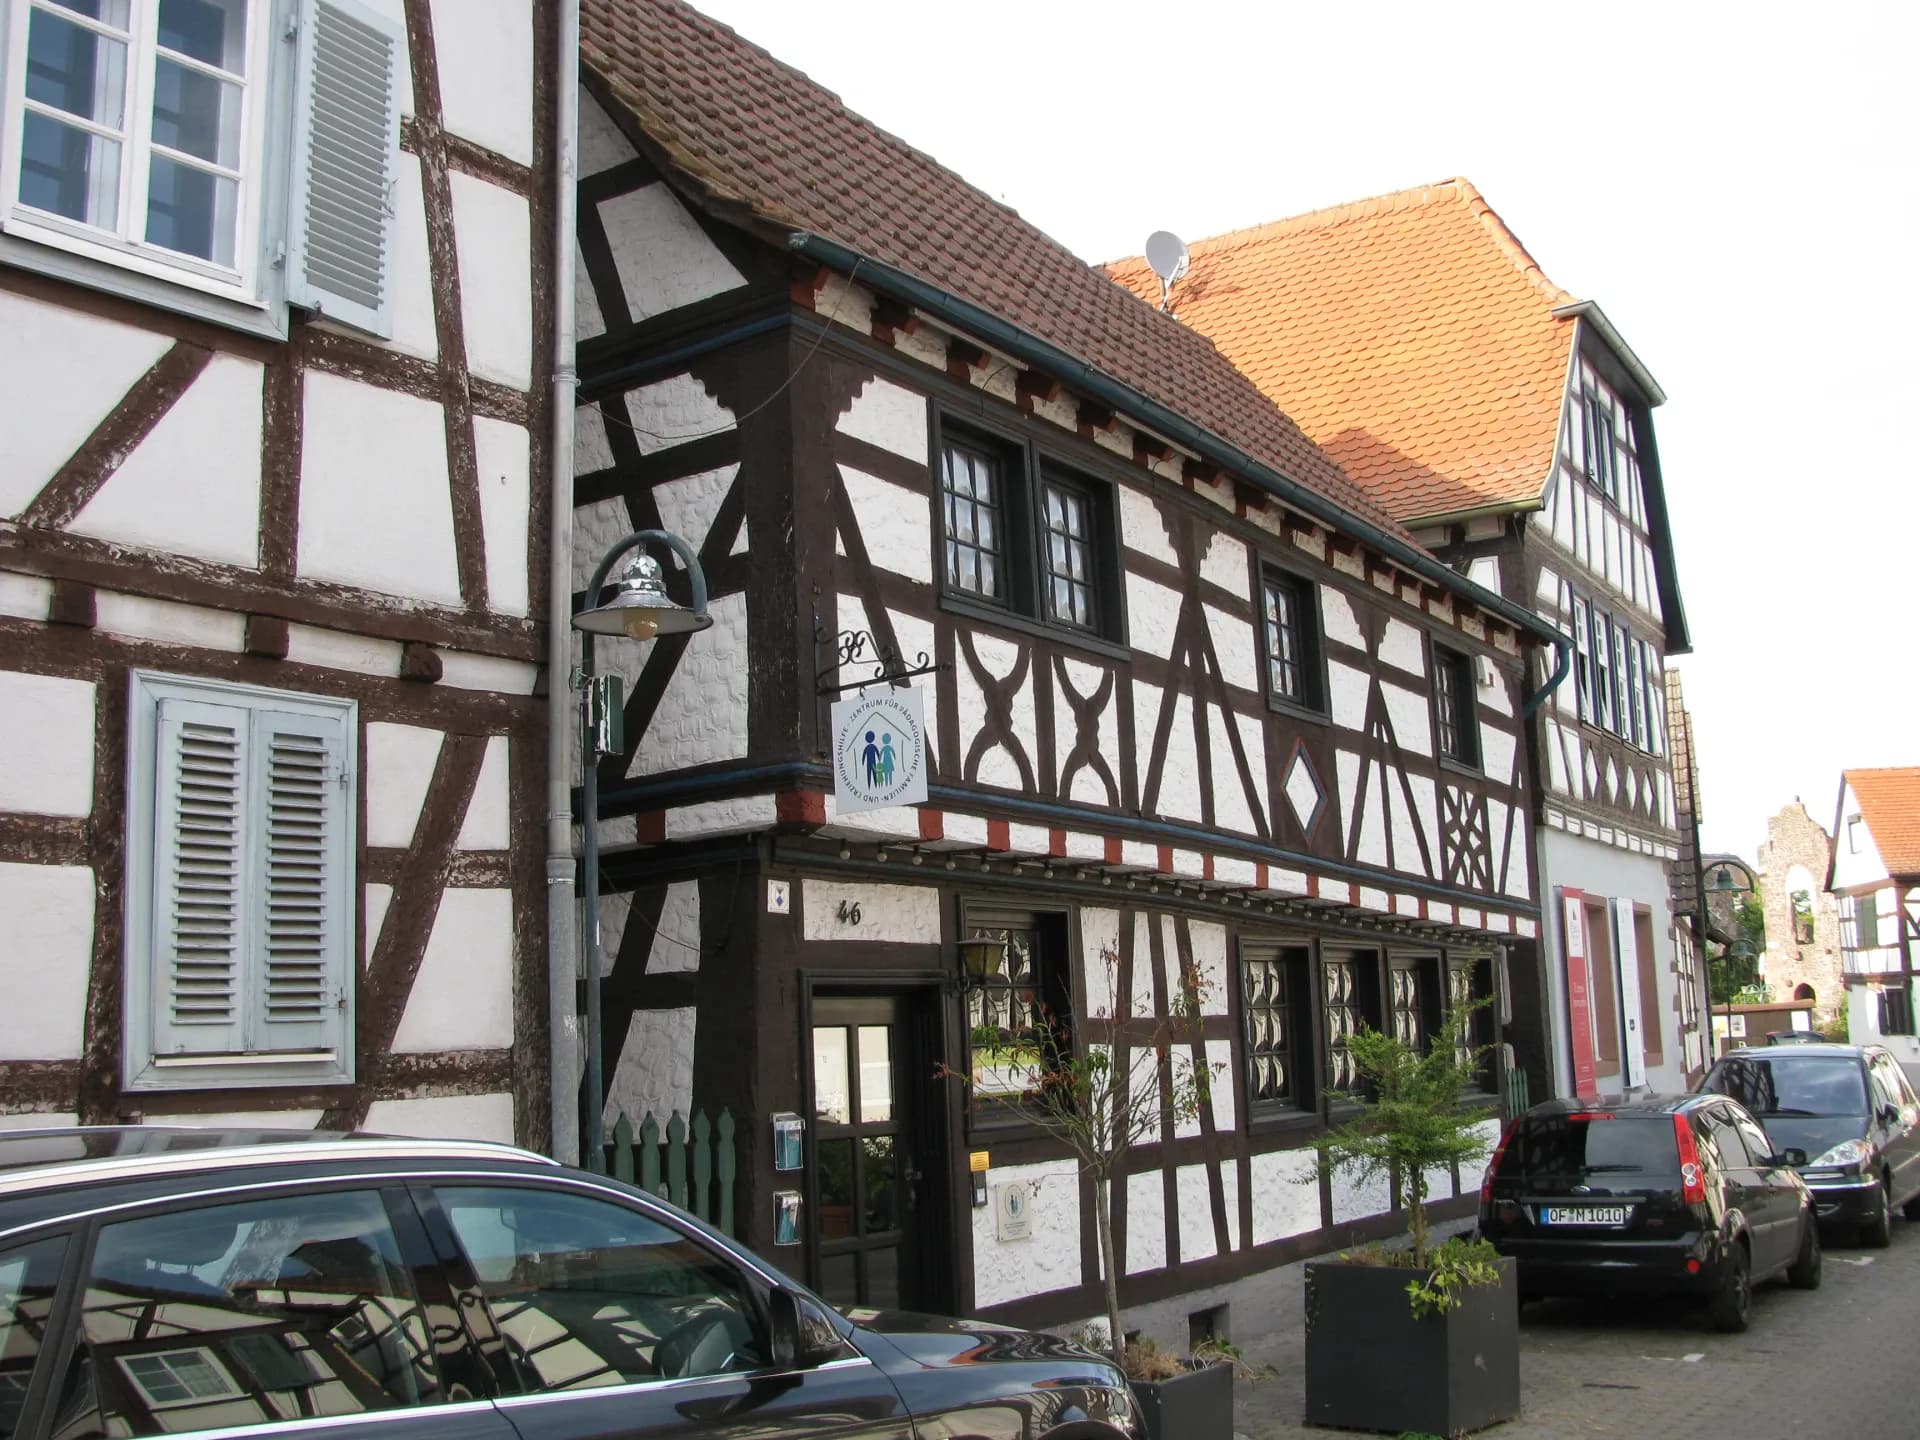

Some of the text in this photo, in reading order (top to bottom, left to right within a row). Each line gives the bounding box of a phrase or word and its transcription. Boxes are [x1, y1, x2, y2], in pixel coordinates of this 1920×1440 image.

[849, 699, 883, 722] ZENTRUM
[884, 699, 899, 710] FÜR
[899, 705, 921, 772] PÄDAGOGISCHE
[837, 727, 863, 799] ERZIEHUNGSHILFE
[863, 794, 880, 804] UND
[836, 900, 861, 925] 46
[1549, 1208, 1567, 1222] OF
